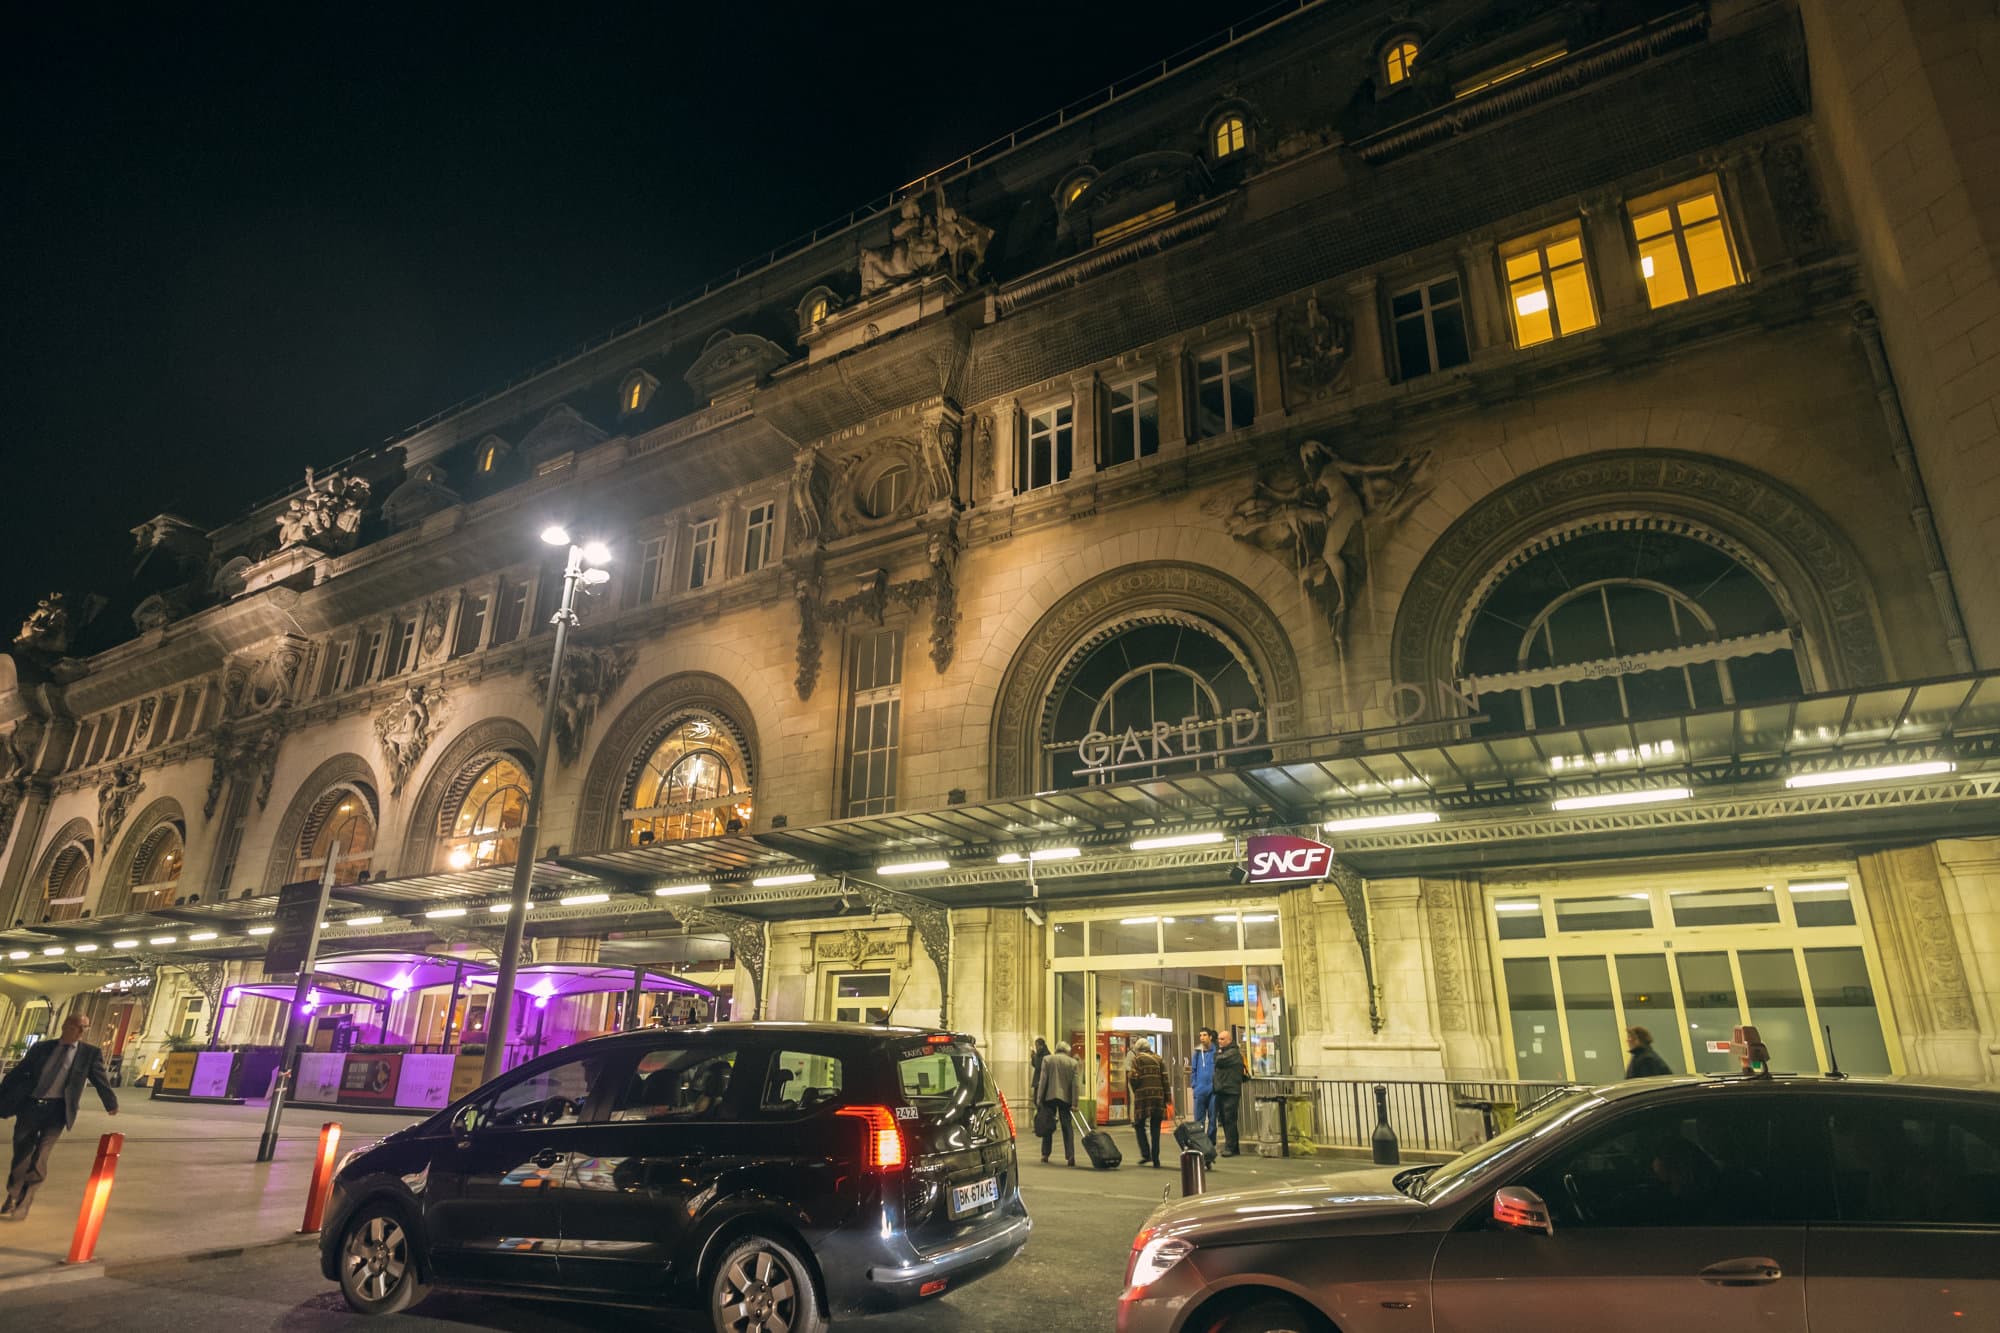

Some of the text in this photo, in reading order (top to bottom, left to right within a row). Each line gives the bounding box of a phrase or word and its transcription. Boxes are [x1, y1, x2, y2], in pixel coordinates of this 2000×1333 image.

[1079, 715, 1201, 767] GARE
[1231, 700, 1297, 745] DE
[1250, 848, 1325, 876] SNCF
[896, 1107, 918, 1119] 2422
